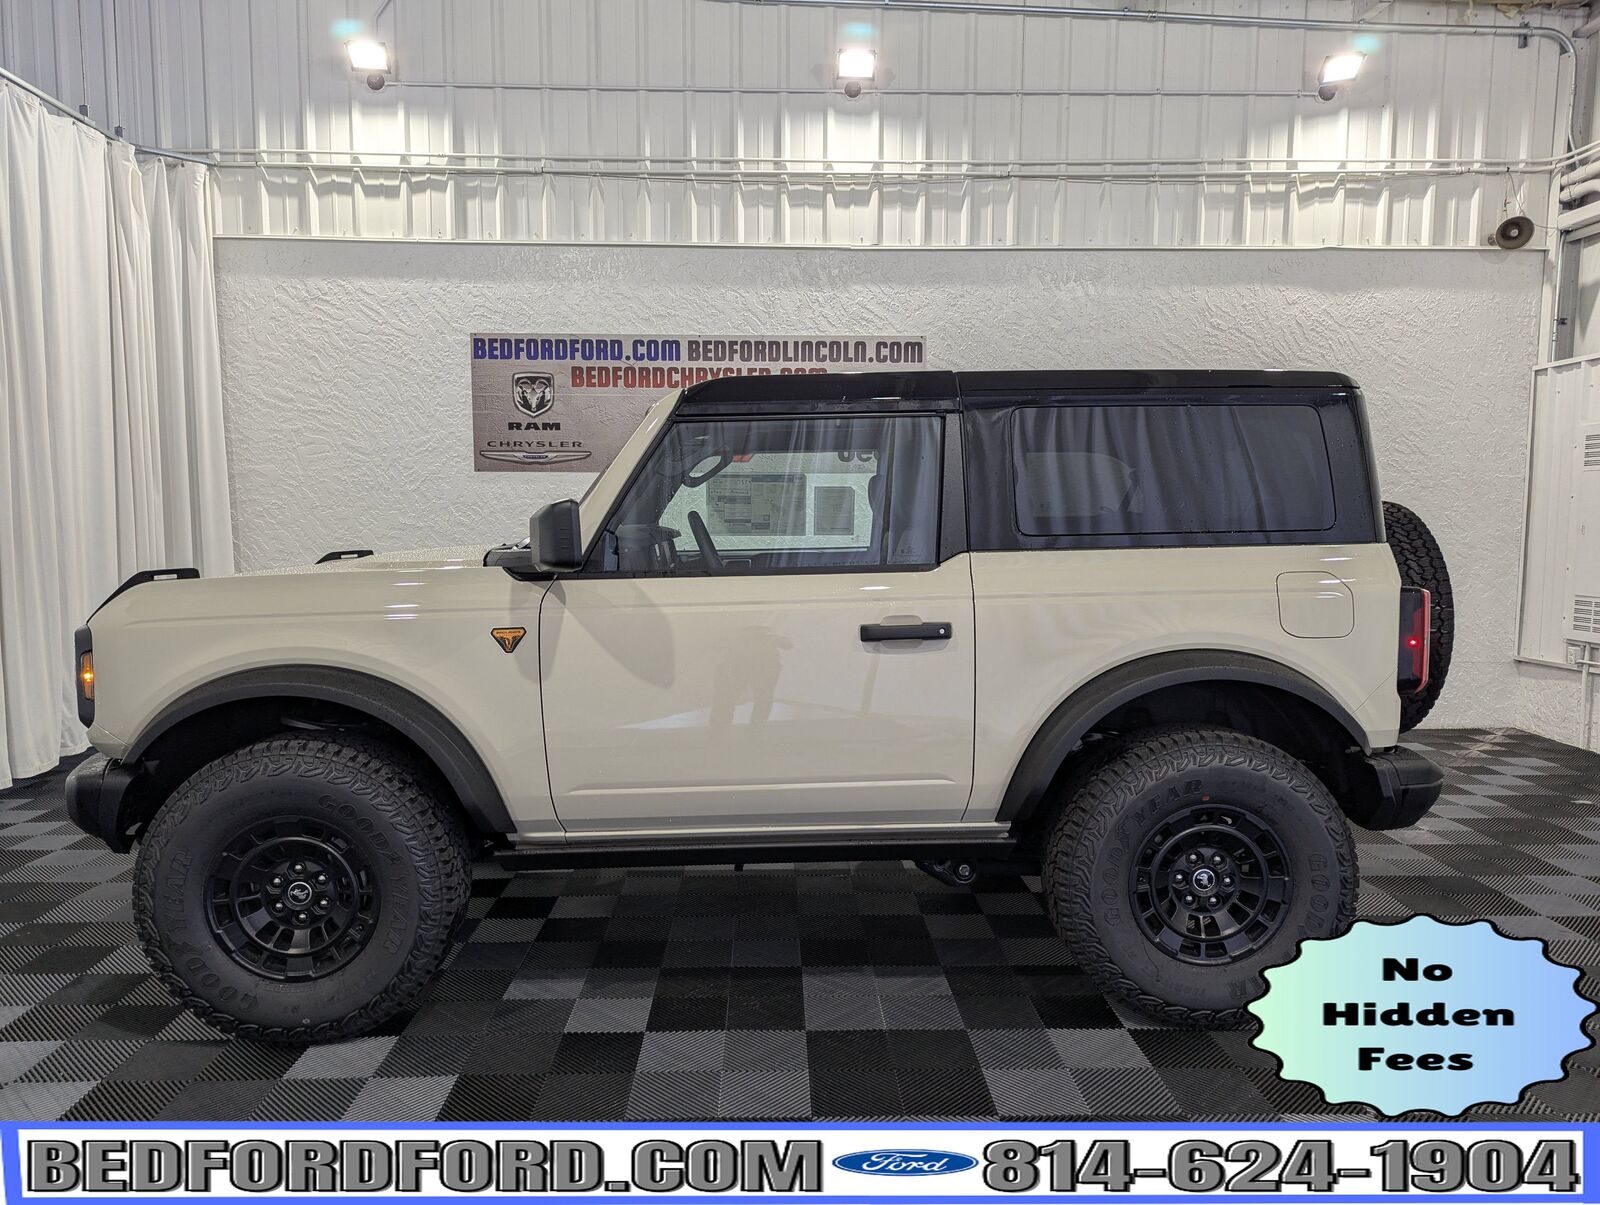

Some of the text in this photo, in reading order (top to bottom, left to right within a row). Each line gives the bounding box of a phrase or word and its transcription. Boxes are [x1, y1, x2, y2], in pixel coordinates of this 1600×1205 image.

[473, 337, 923, 363] BEDFORDFORD.COM BEDFORDLINCOLN.COM
[571, 366, 828, 389] BEDFORDCHRY
[507, 422, 561, 431] RAM
[487, 440, 582, 448] CHRYSLER
